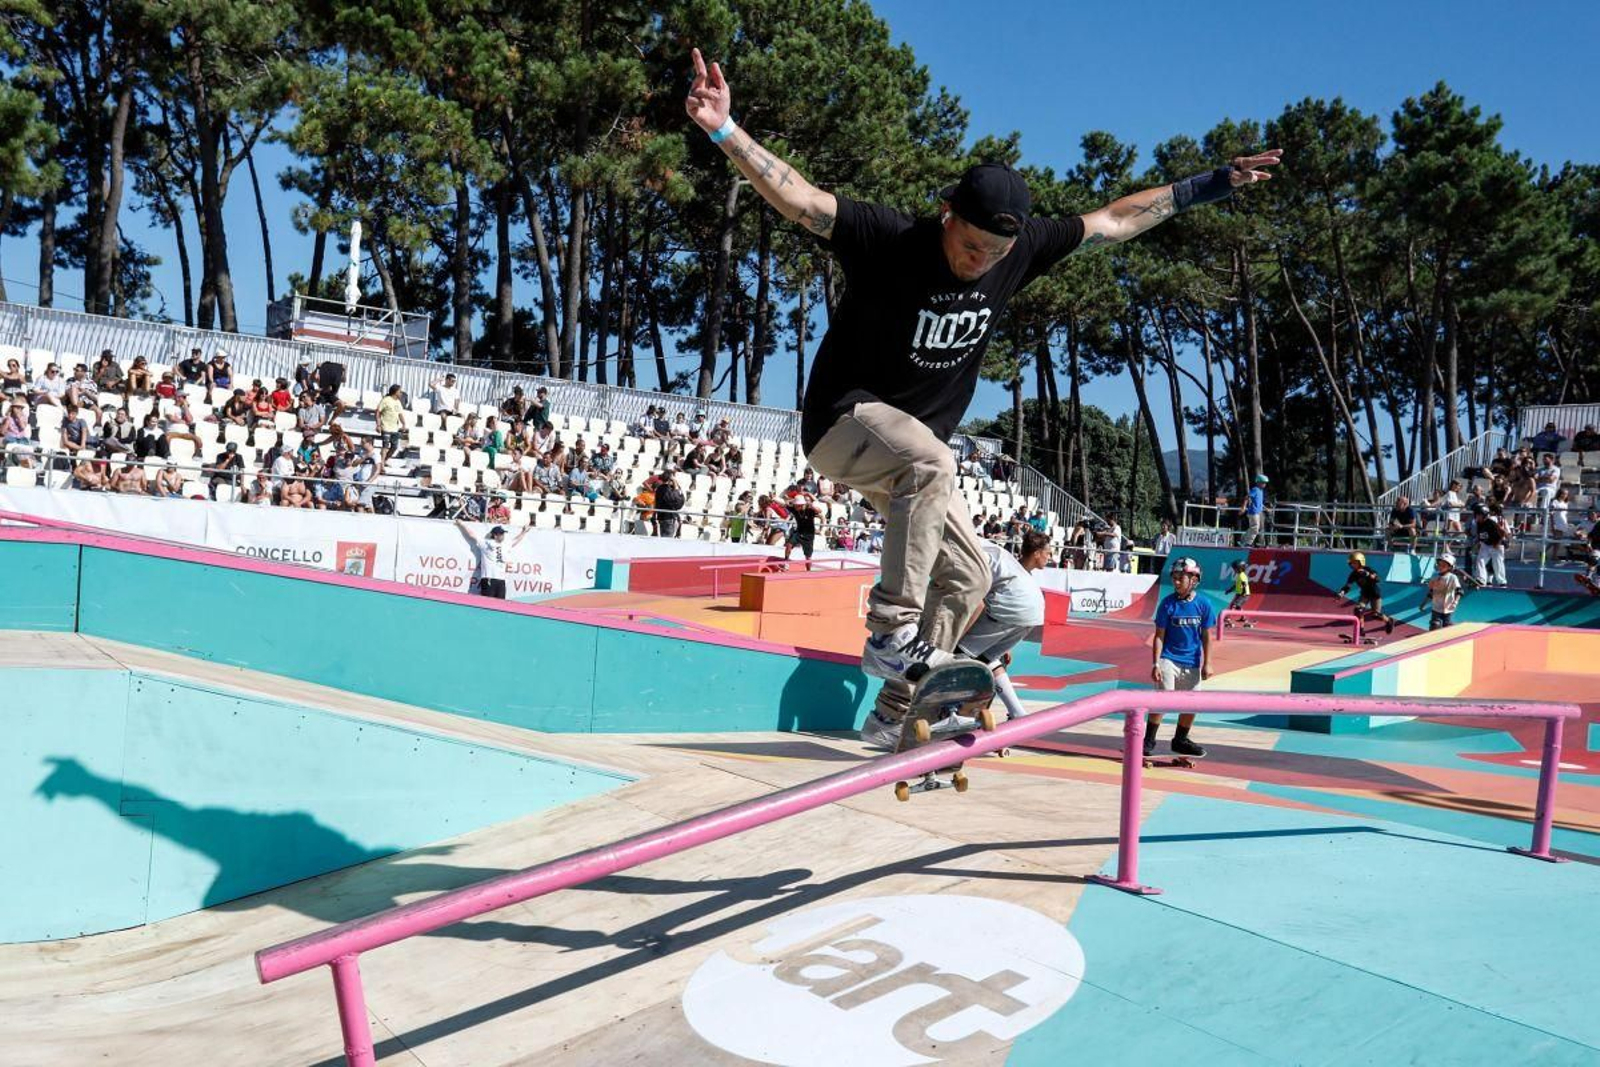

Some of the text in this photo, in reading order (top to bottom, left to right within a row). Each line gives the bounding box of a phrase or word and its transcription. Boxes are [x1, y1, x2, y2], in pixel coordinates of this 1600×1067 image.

[236, 545, 322, 563] CONCELLO
[504, 562, 542, 576] EJOR
[404, 573, 464, 588] CIUDAD
[513, 580, 552, 593] VIVIR
